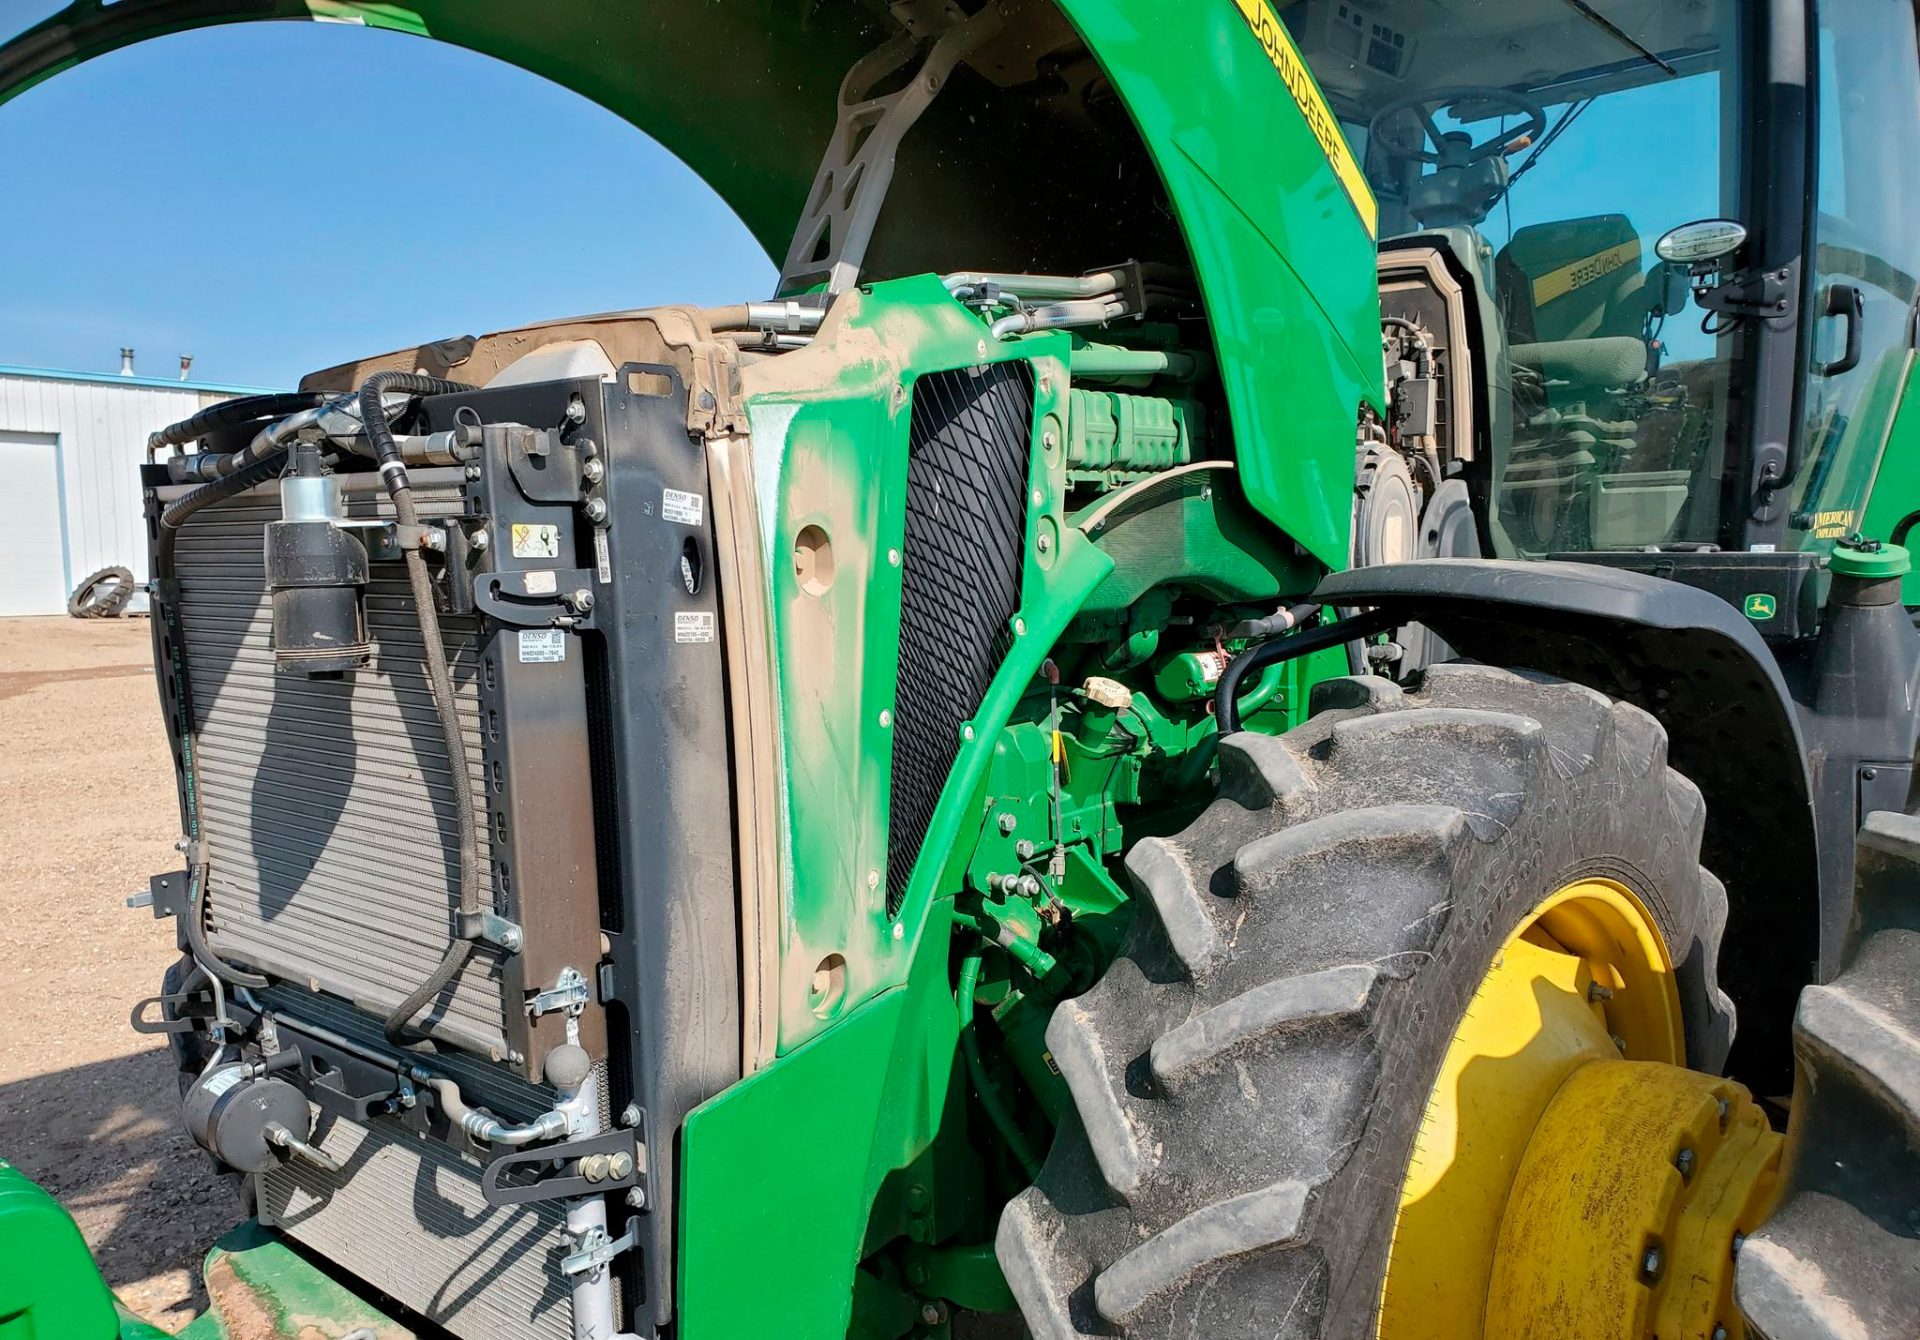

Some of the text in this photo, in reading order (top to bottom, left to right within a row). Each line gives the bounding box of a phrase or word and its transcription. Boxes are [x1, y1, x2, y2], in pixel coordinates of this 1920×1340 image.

[665, 491, 687, 501] DENSO
[1814, 510, 1854, 529] AMERICAN
[522, 632, 547, 640] DENSO
